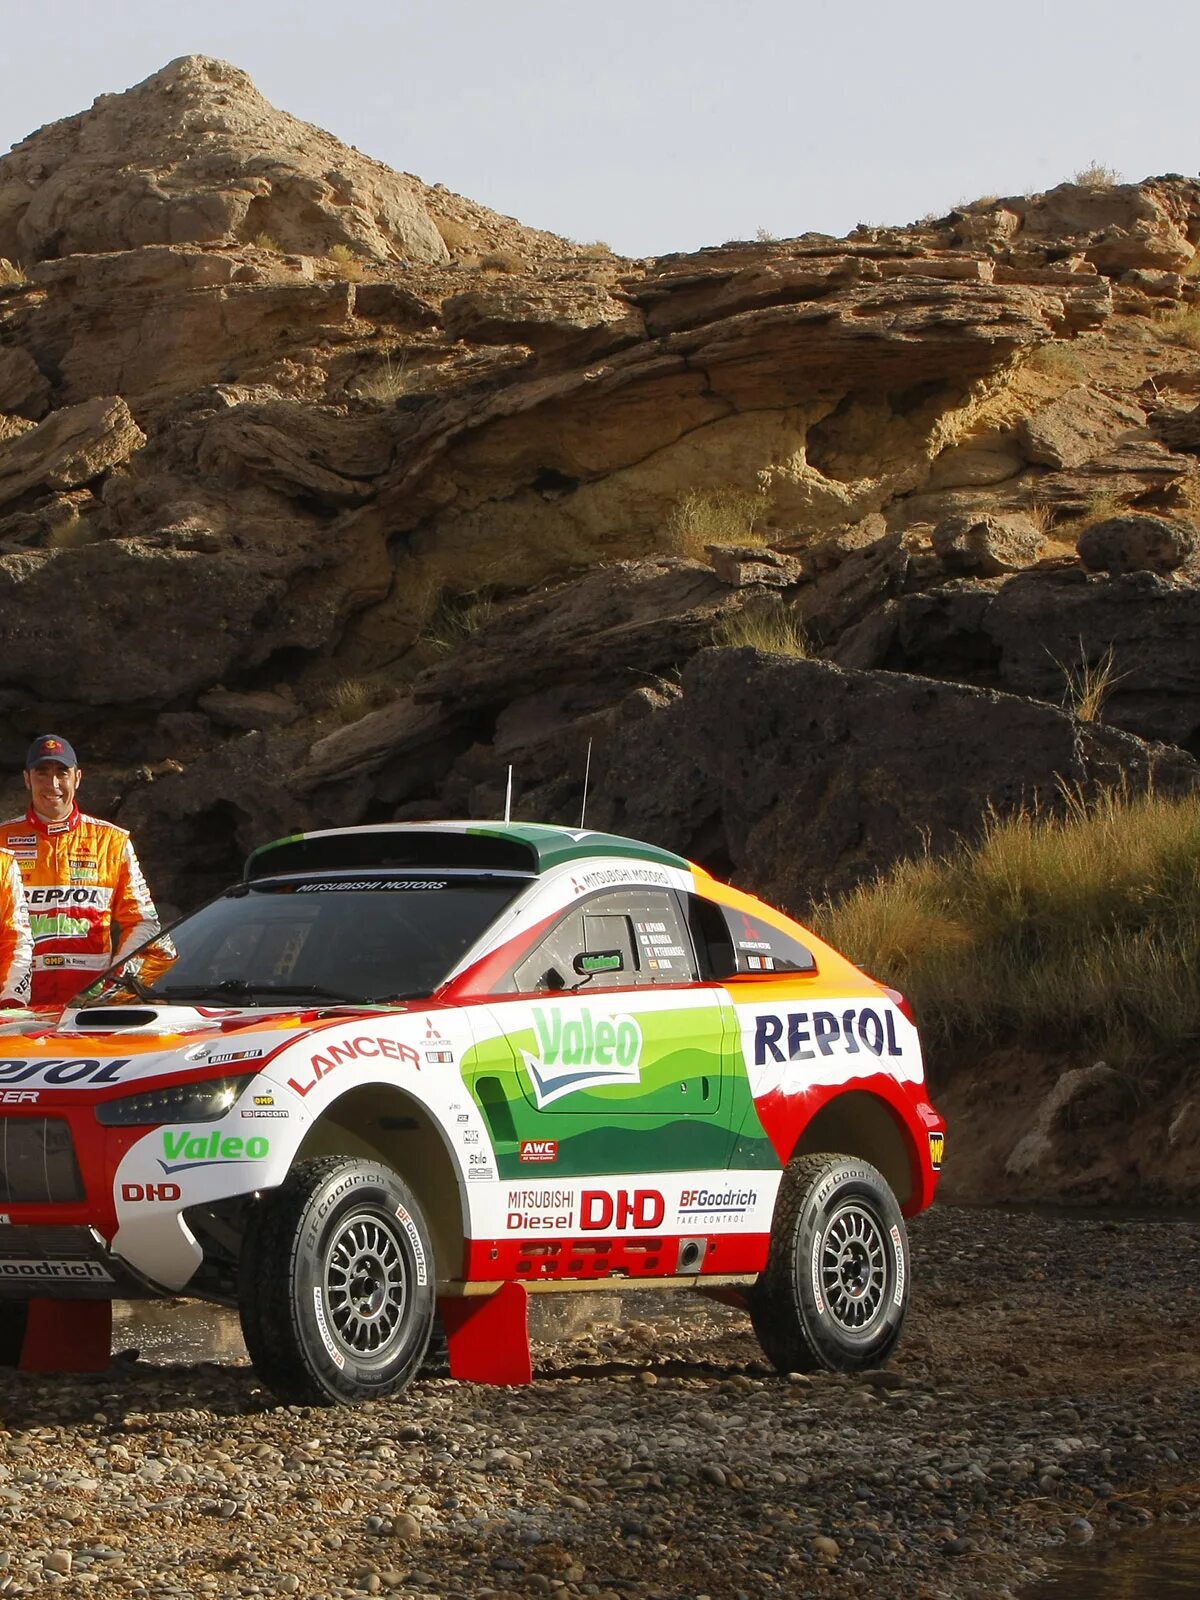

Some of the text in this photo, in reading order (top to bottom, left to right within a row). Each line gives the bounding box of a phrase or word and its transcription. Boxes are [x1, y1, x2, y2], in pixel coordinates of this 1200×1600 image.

[296, 881, 448, 893] MITSUBISHI MOTORS
[583, 869, 668, 888] MITSUBISHI MOTORS
[44, 956, 64, 966] OMP
[582, 955, 620, 970] Valeo
[532, 1007, 639, 1067] Valeo
[755, 1008, 903, 1066] REPSOL
[287, 1036, 421, 1097] LANCER
[255, 1097, 272, 1105] OMP
[255, 1110, 288, 1118] FACOM
[163, 1131, 270, 1160] Valeo
[523, 1142, 555, 1154] AWC
[508, 1190, 574, 1209] MITSUBISHI
[679, 1189, 757, 1207] BFGoodrich
[307, 1174, 386, 1250] BFGoodrich
[506, 1211, 573, 1230] Diesel
[676, 1214, 745, 1225] TAKE CONTROL
[396, 1207, 426, 1284] BFGoodrich
[890, 1227, 904, 1305] BFGoodrich
[315, 1289, 345, 1367] BFGoodrich
